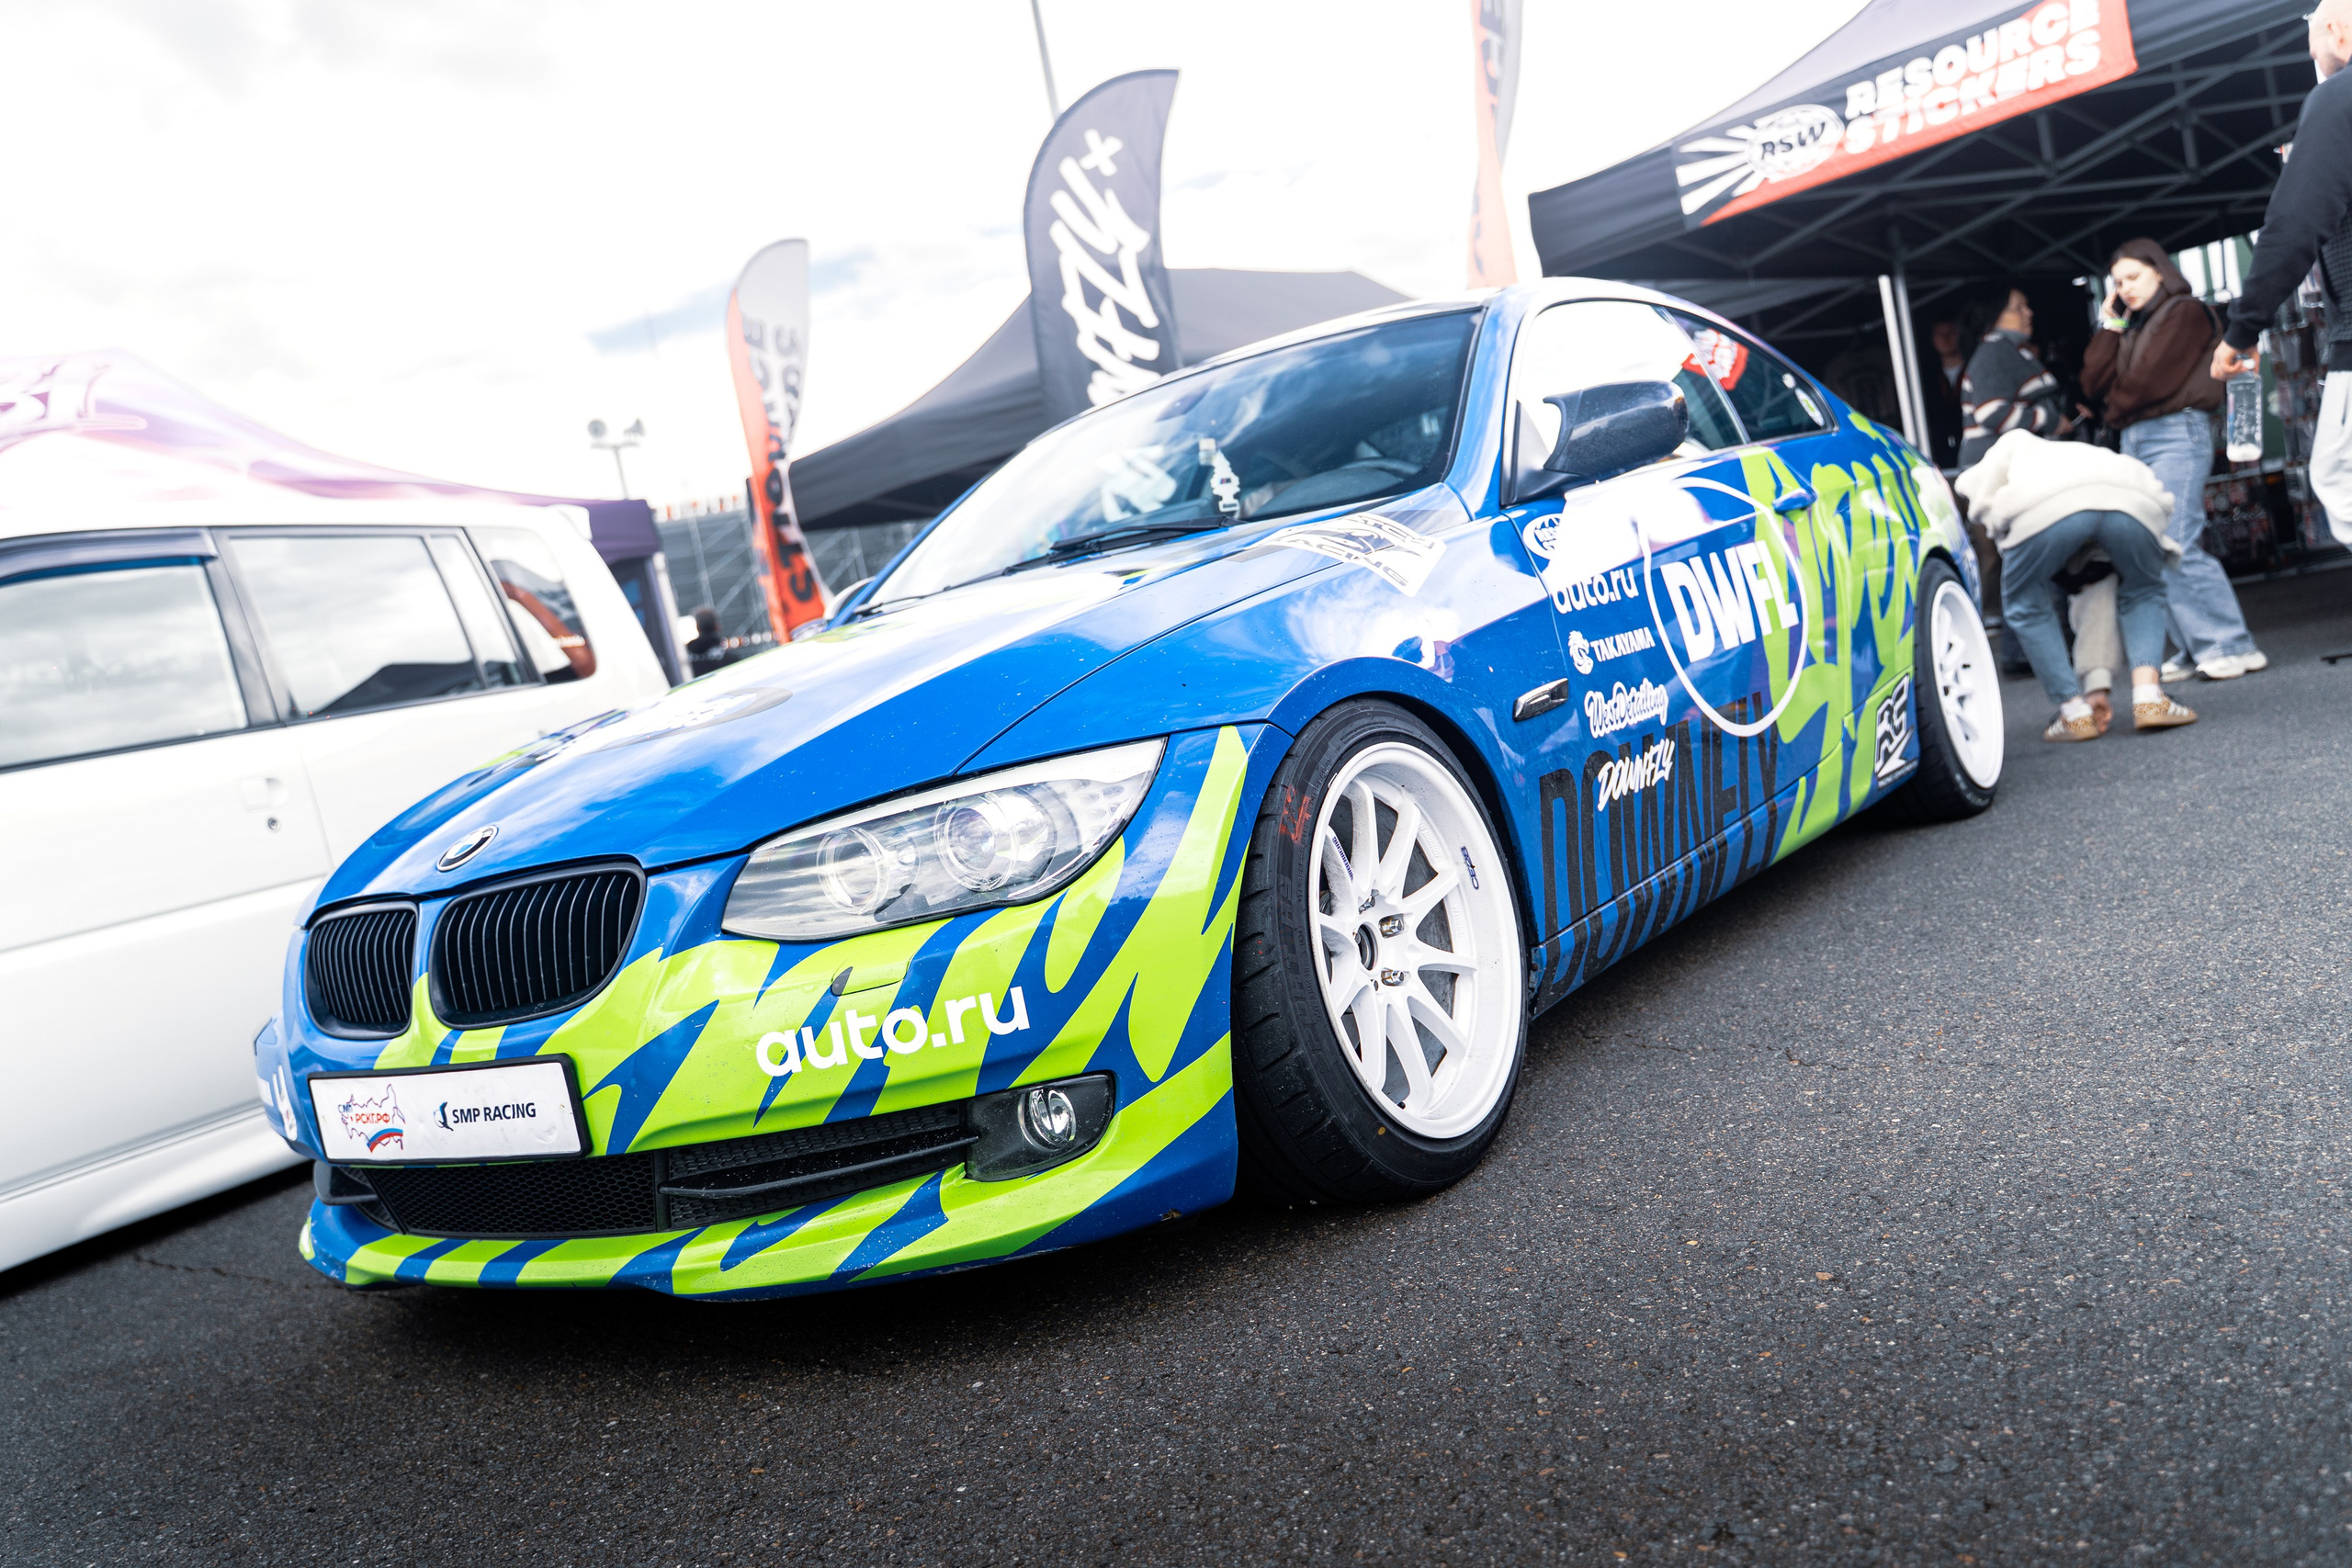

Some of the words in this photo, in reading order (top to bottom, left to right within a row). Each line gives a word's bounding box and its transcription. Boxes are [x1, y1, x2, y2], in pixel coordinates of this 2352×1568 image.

[1842, 29, 2101, 154] STICKERS
[1844, 0, 2100, 120] RESOURCE
[1761, 121, 1826, 161] RSW
[1552, 567, 1639, 615] auto.ru
[1659, 540, 1800, 663] DWFL
[1590, 626, 1657, 662] TAKAYAMA
[1597, 738, 1676, 812] DOWNFLY
[755, 986, 1031, 1077] auto.ru
[452, 1107, 481, 1124] SMP
[483, 1101, 537, 1122] RACING
